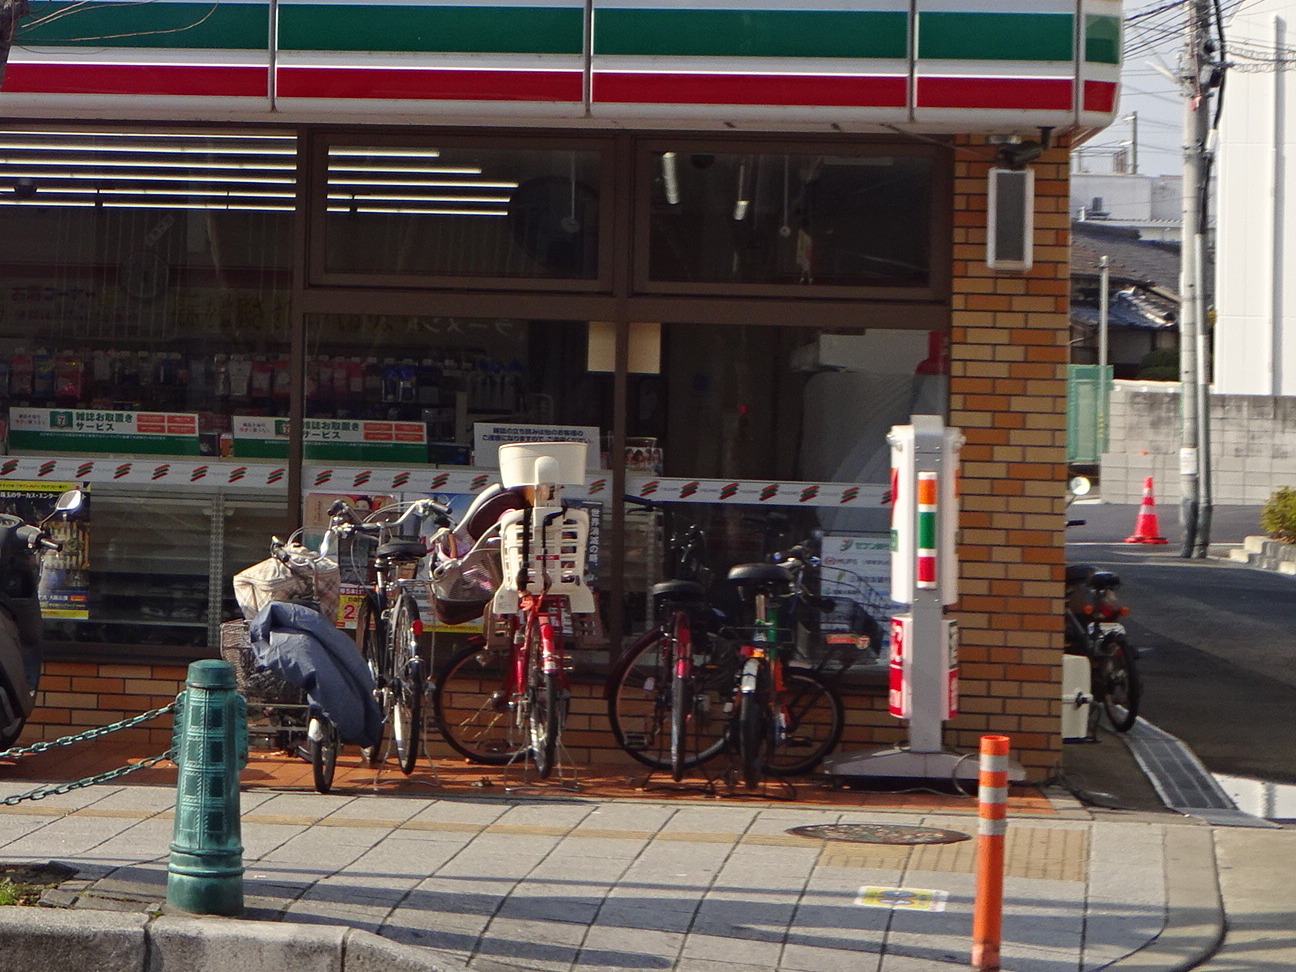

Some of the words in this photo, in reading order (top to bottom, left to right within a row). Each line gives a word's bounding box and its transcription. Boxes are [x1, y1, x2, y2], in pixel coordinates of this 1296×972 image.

[75, 411, 133, 423] 雑誌お取置き
[76, 422, 115, 432] サービス
